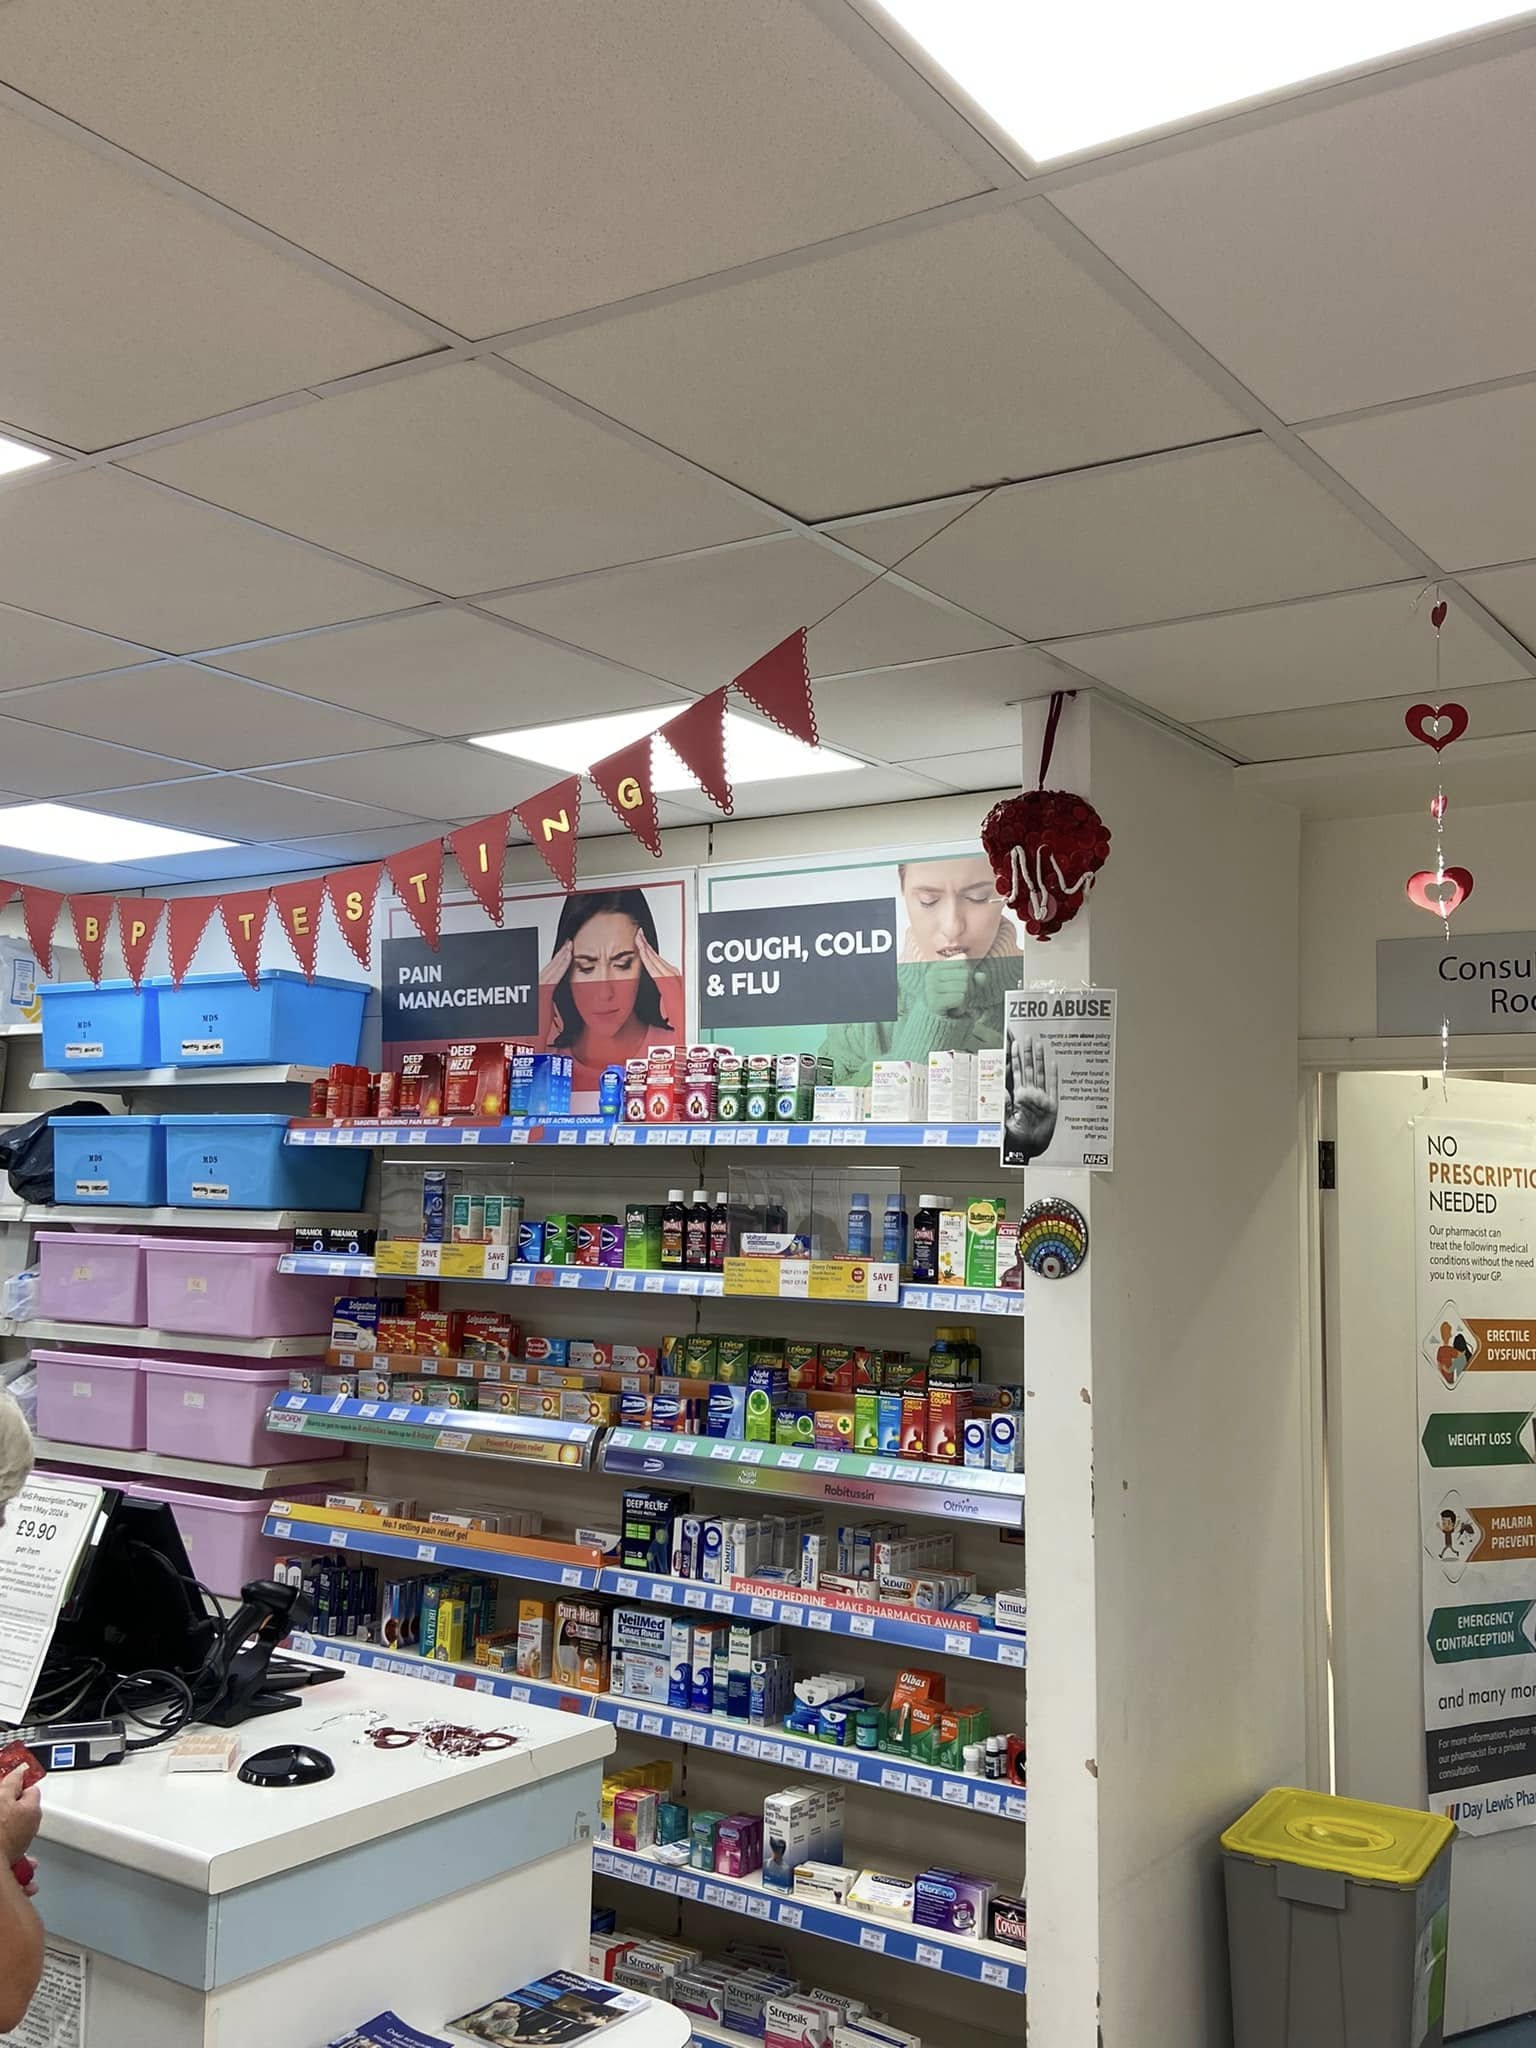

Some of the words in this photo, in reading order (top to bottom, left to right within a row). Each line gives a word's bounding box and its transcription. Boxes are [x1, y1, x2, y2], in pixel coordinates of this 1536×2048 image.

[706, 934, 809, 964] COUGH,
[814, 928, 894, 957] COLD
[398, 964, 443, 986] PAIN
[706, 974, 726, 998] &
[731, 970, 781, 996] FLU
[398, 984, 532, 1011] MANAGEMENT
[1009, 1000, 1048, 1019] ZERO
[1052, 999, 1112, 1018] ABUSE
[450, 1045, 477, 1057] DEEP
[402, 1055, 425, 1064] DEEP
[450, 1059, 473, 1071] HEAT
[512, 1057, 535, 1067] DEEP
[402, 1065, 422, 1075] HEAT
[512, 1069, 534, 1078] FREEZE
[1428, 1135, 1458, 1157] NO
[1084, 1154, 1108, 1165] NHS
[1429, 1191, 1498, 1214] NEEDED
[970, 1211, 996, 1223] Buttercup
[295, 1228, 323, 1237] PARAMOL
[330, 1229, 358, 1238] PARAMOL
[1429, 1224, 1445, 1236] Our
[1445, 1226, 1488, 1239] pharmacist
[1488, 1230, 1502, 1239] can
[421, 1249, 439, 1259] SAVE
[1429, 1241, 1448, 1251] treat
[1449, 1241, 1463, 1251] the
[1463, 1241, 1498, 1255] following
[1499, 1243, 1529, 1254] medical
[487, 1252, 505, 1261] SAVE
[1429, 1255, 1470, 1267] conditions
[1471, 1256, 1501, 1268] without
[1501, 1258, 1514, 1268] the
[1515, 1258, 1535, 1268] need
[491, 1262, 501, 1271] £1
[872, 1272, 894, 1281] SAVE
[1429, 1273, 1445, 1282] you
[1446, 1271, 1455, 1280] to
[1456, 1271, 1471, 1281] visit
[1471, 1273, 1490, 1283] your
[877, 1284, 888, 1292] £1
[1486, 1330, 1530, 1343] ERECTILE
[751, 1376, 770, 1386] Nurse
[752, 1369, 770, 1379] Night
[779, 1412, 795, 1420] Night
[1448, 1434, 1487, 1447] WEIGHT
[1489, 1432, 1512, 1446] LOSS
[824, 1483, 875, 1502] Robitussin
[33, 1493, 66, 1506] Prescription
[66, 1499, 88, 1510] Charge
[626, 1498, 644, 1508] DEEP
[643, 1500, 670, 1511] RELIEF
[943, 1499, 980, 1515] Otrivine
[36, 1506, 49, 1516] May
[16, 1519, 57, 1541] £9.90
[382, 1518, 398, 1529] No.1
[398, 1523, 421, 1535] selling
[421, 1526, 437, 1538] pain
[437, 1526, 457, 1538] relief
[456, 1531, 469, 1541] gel
[1491, 1515, 1533, 1530] MALARIA
[15, 1546, 27, 1554] per
[881, 1576, 912, 1591] SUDAFED
[558, 1604, 600, 1624] Cura-Heat
[735, 1581, 827, 1607] PSEUDOEPHEDRINE
[836, 1600, 864, 1613] MAKE
[866, 1603, 933, 1626] PHARMACIST
[934, 1616, 973, 1632] AWARE
[618, 1612, 665, 1630] NeilMed
[1457, 1611, 1515, 1630] EMERGENCY
[621, 1623, 640, 1636] SINUS
[640, 1627, 661, 1639] RINSE
[1435, 1631, 1515, 1652] CONTRACEPTION
[901, 1672, 927, 1688] Olbas
[1438, 1688, 1465, 1711] and
[1468, 1688, 1507, 1707] many
[913, 1709, 930, 1720] Olbas
[1438, 1738, 1450, 1749] For
[1450, 1737, 1468, 1747] more
[1508, 1727, 1530, 1739] please
[1438, 1755, 1450, 1765] our
[1450, 1747, 1487, 1763] pharmacist
[1487, 1745, 1498, 1756] for
[1503, 1742, 1527, 1756] private
[1463, 1802, 1483, 1819] Day
[1486, 1795, 1514, 1813] Lewis
[1516, 1788, 1536, 1805] Pha
[629, 1956, 665, 1974] Strepsils
[615, 1972, 648, 1988] Strepsils
[675, 1981, 708, 1998] Strepsils
[727, 1985, 766, 2004] Strepsils
[813, 1990, 851, 2009] Strepsils
[769, 2005, 808, 2026] Strepsils
